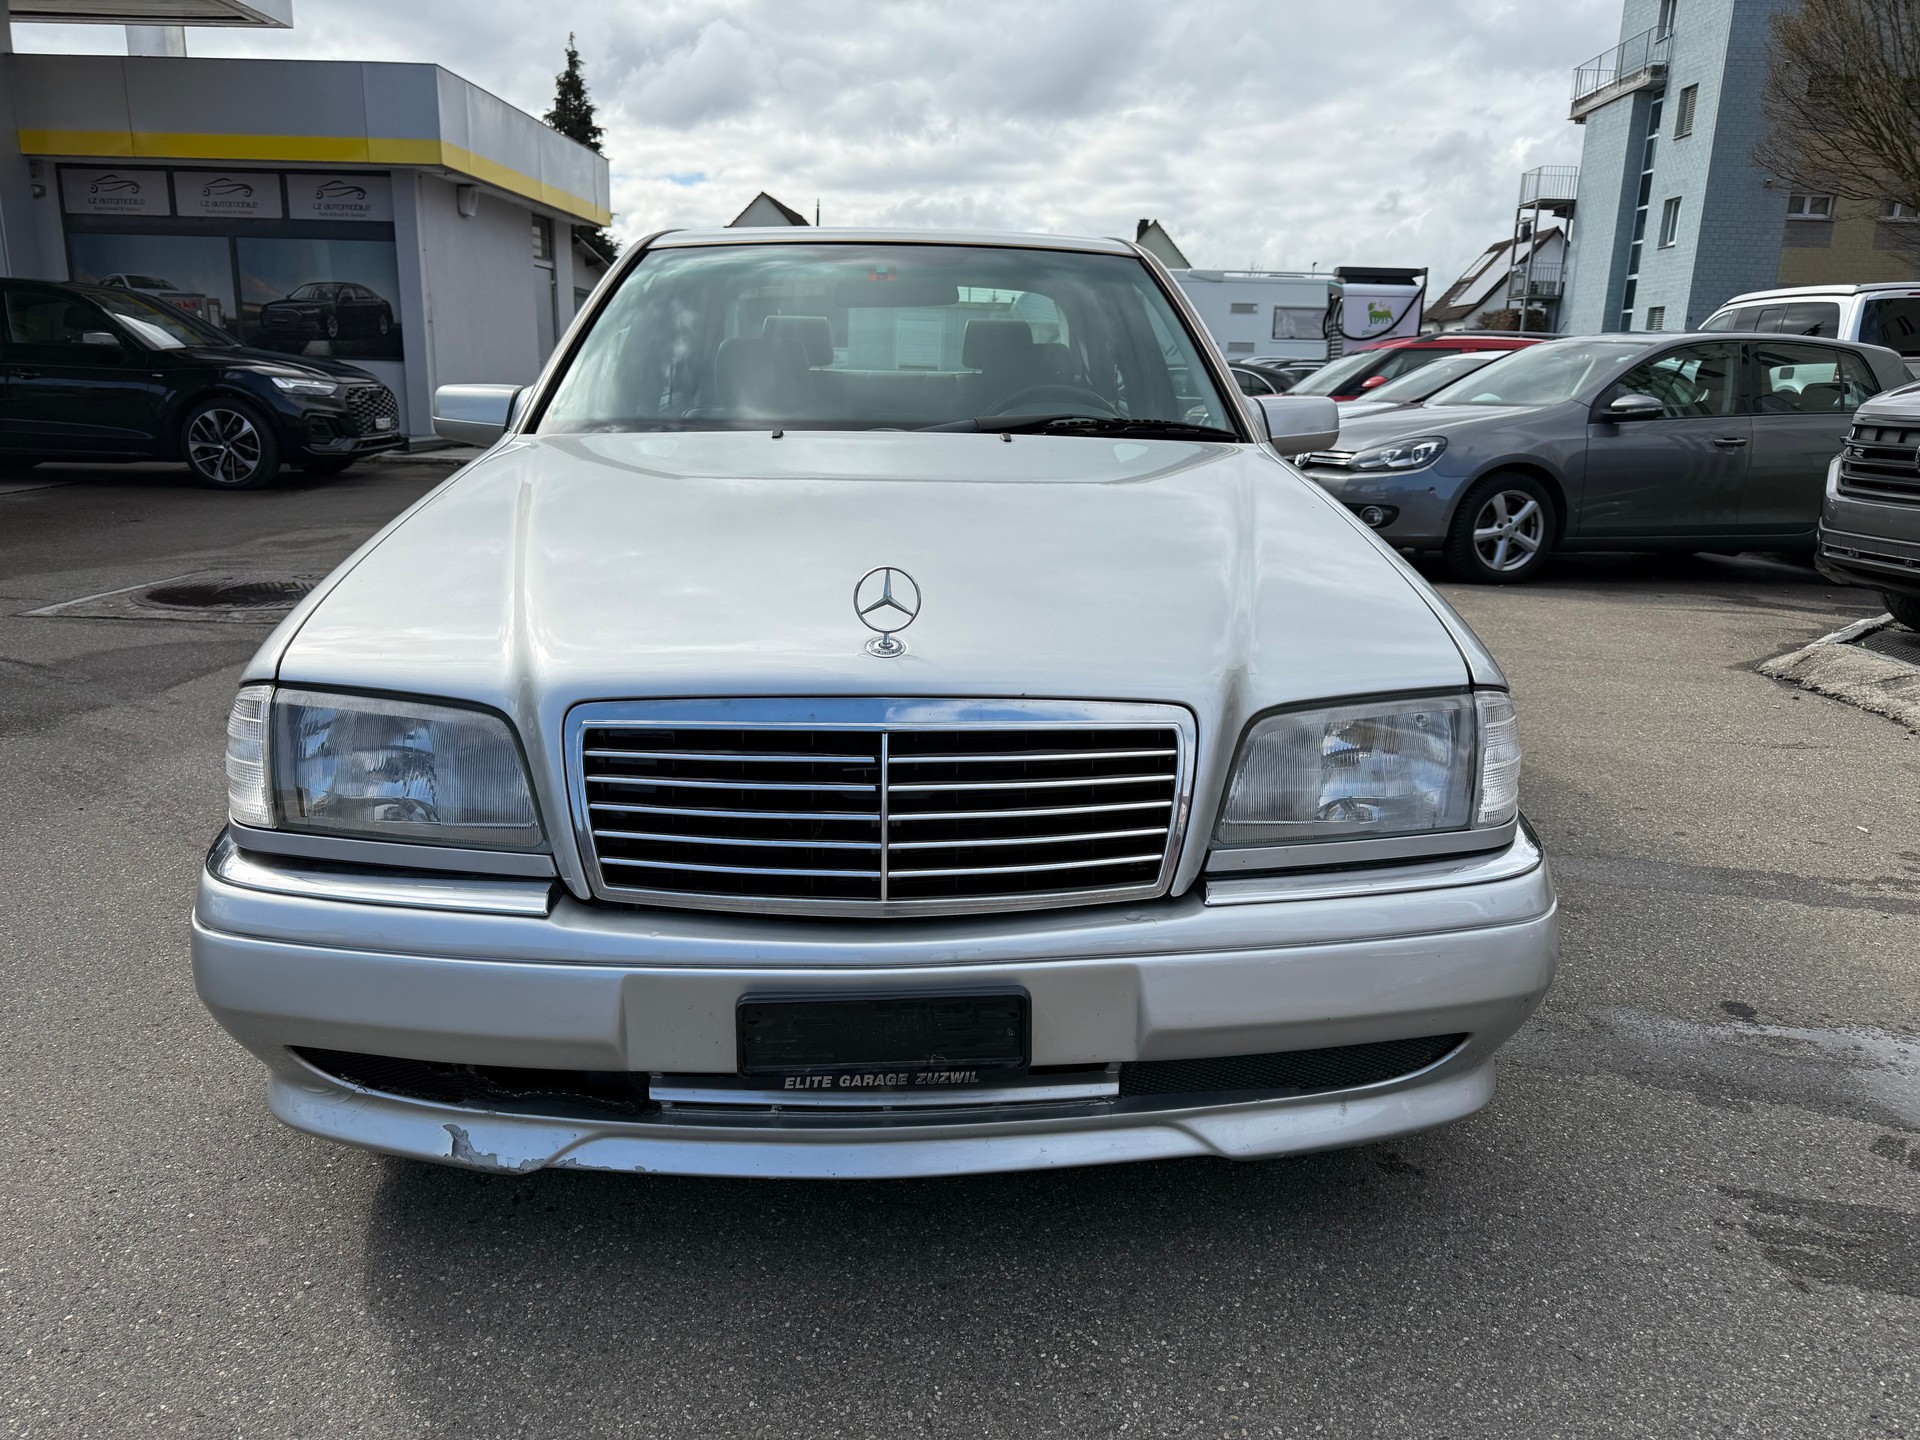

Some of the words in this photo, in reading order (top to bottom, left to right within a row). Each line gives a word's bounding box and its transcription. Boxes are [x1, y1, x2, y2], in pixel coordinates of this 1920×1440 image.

[88, 197, 97, 205] LZ
[200, 200, 209, 208] LZ
[211, 200, 258, 209] automobile
[324, 203, 371, 212] automobile
[784, 1075, 833, 1089] ELITE
[839, 1073, 908, 1087] GARAGE
[915, 1071, 979, 1085] ZUZWIL
